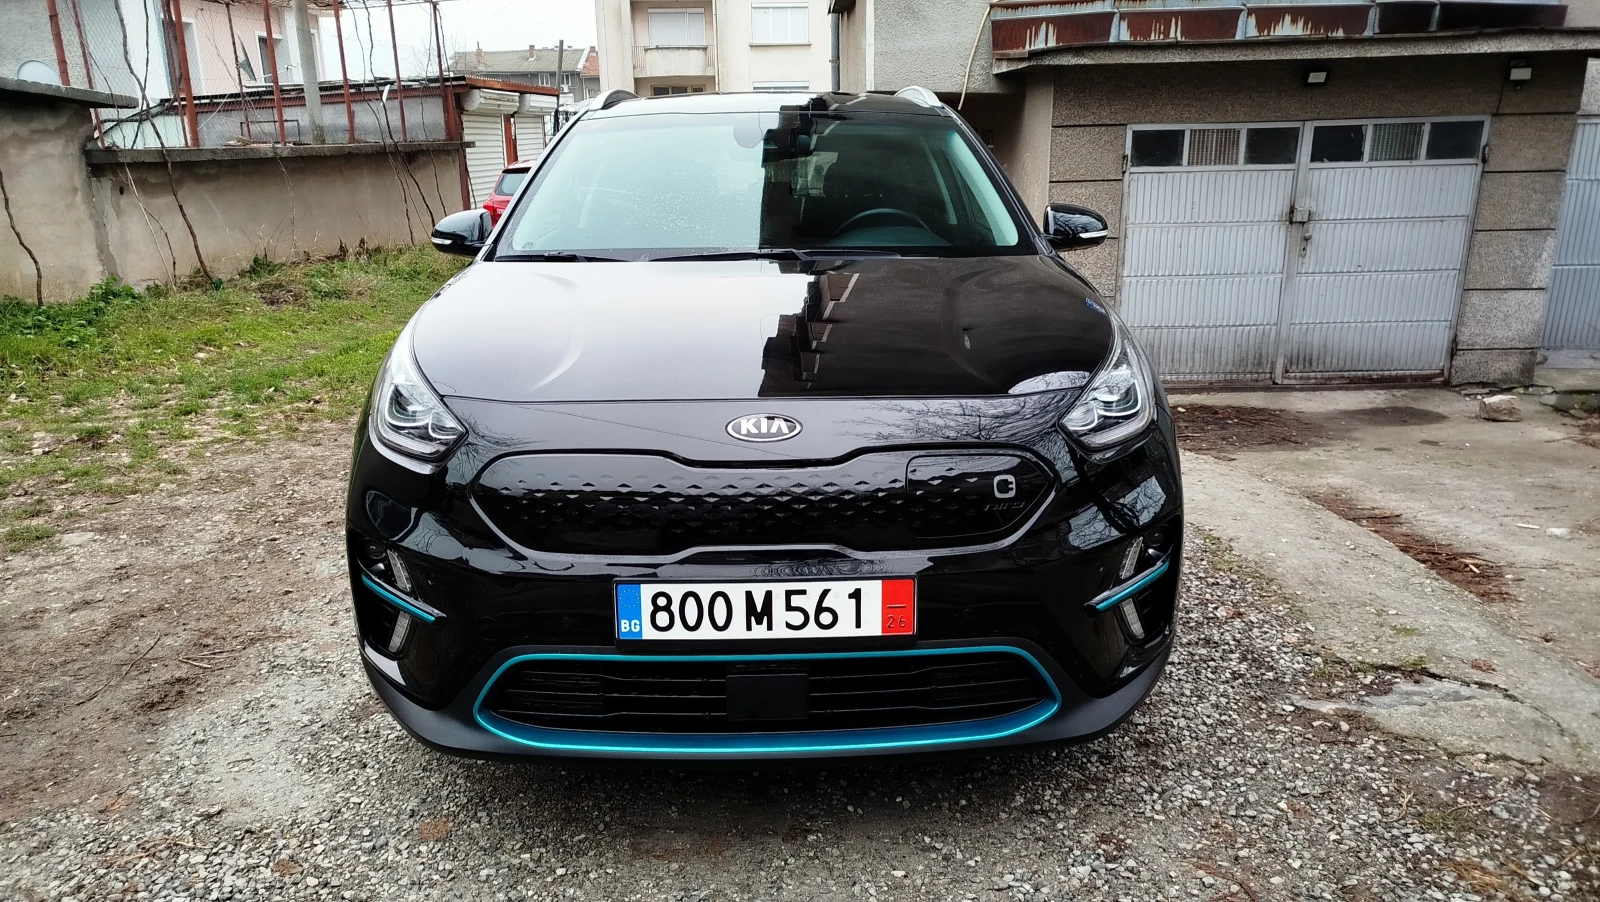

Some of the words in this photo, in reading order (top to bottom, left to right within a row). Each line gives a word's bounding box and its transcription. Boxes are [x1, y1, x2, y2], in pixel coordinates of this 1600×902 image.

[740, 417, 790, 434] KIA
[650, 590, 733, 632] 800
[785, 588, 862, 631] 561
[620, 619, 640, 632] BG
[886, 614, 907, 629] 26
